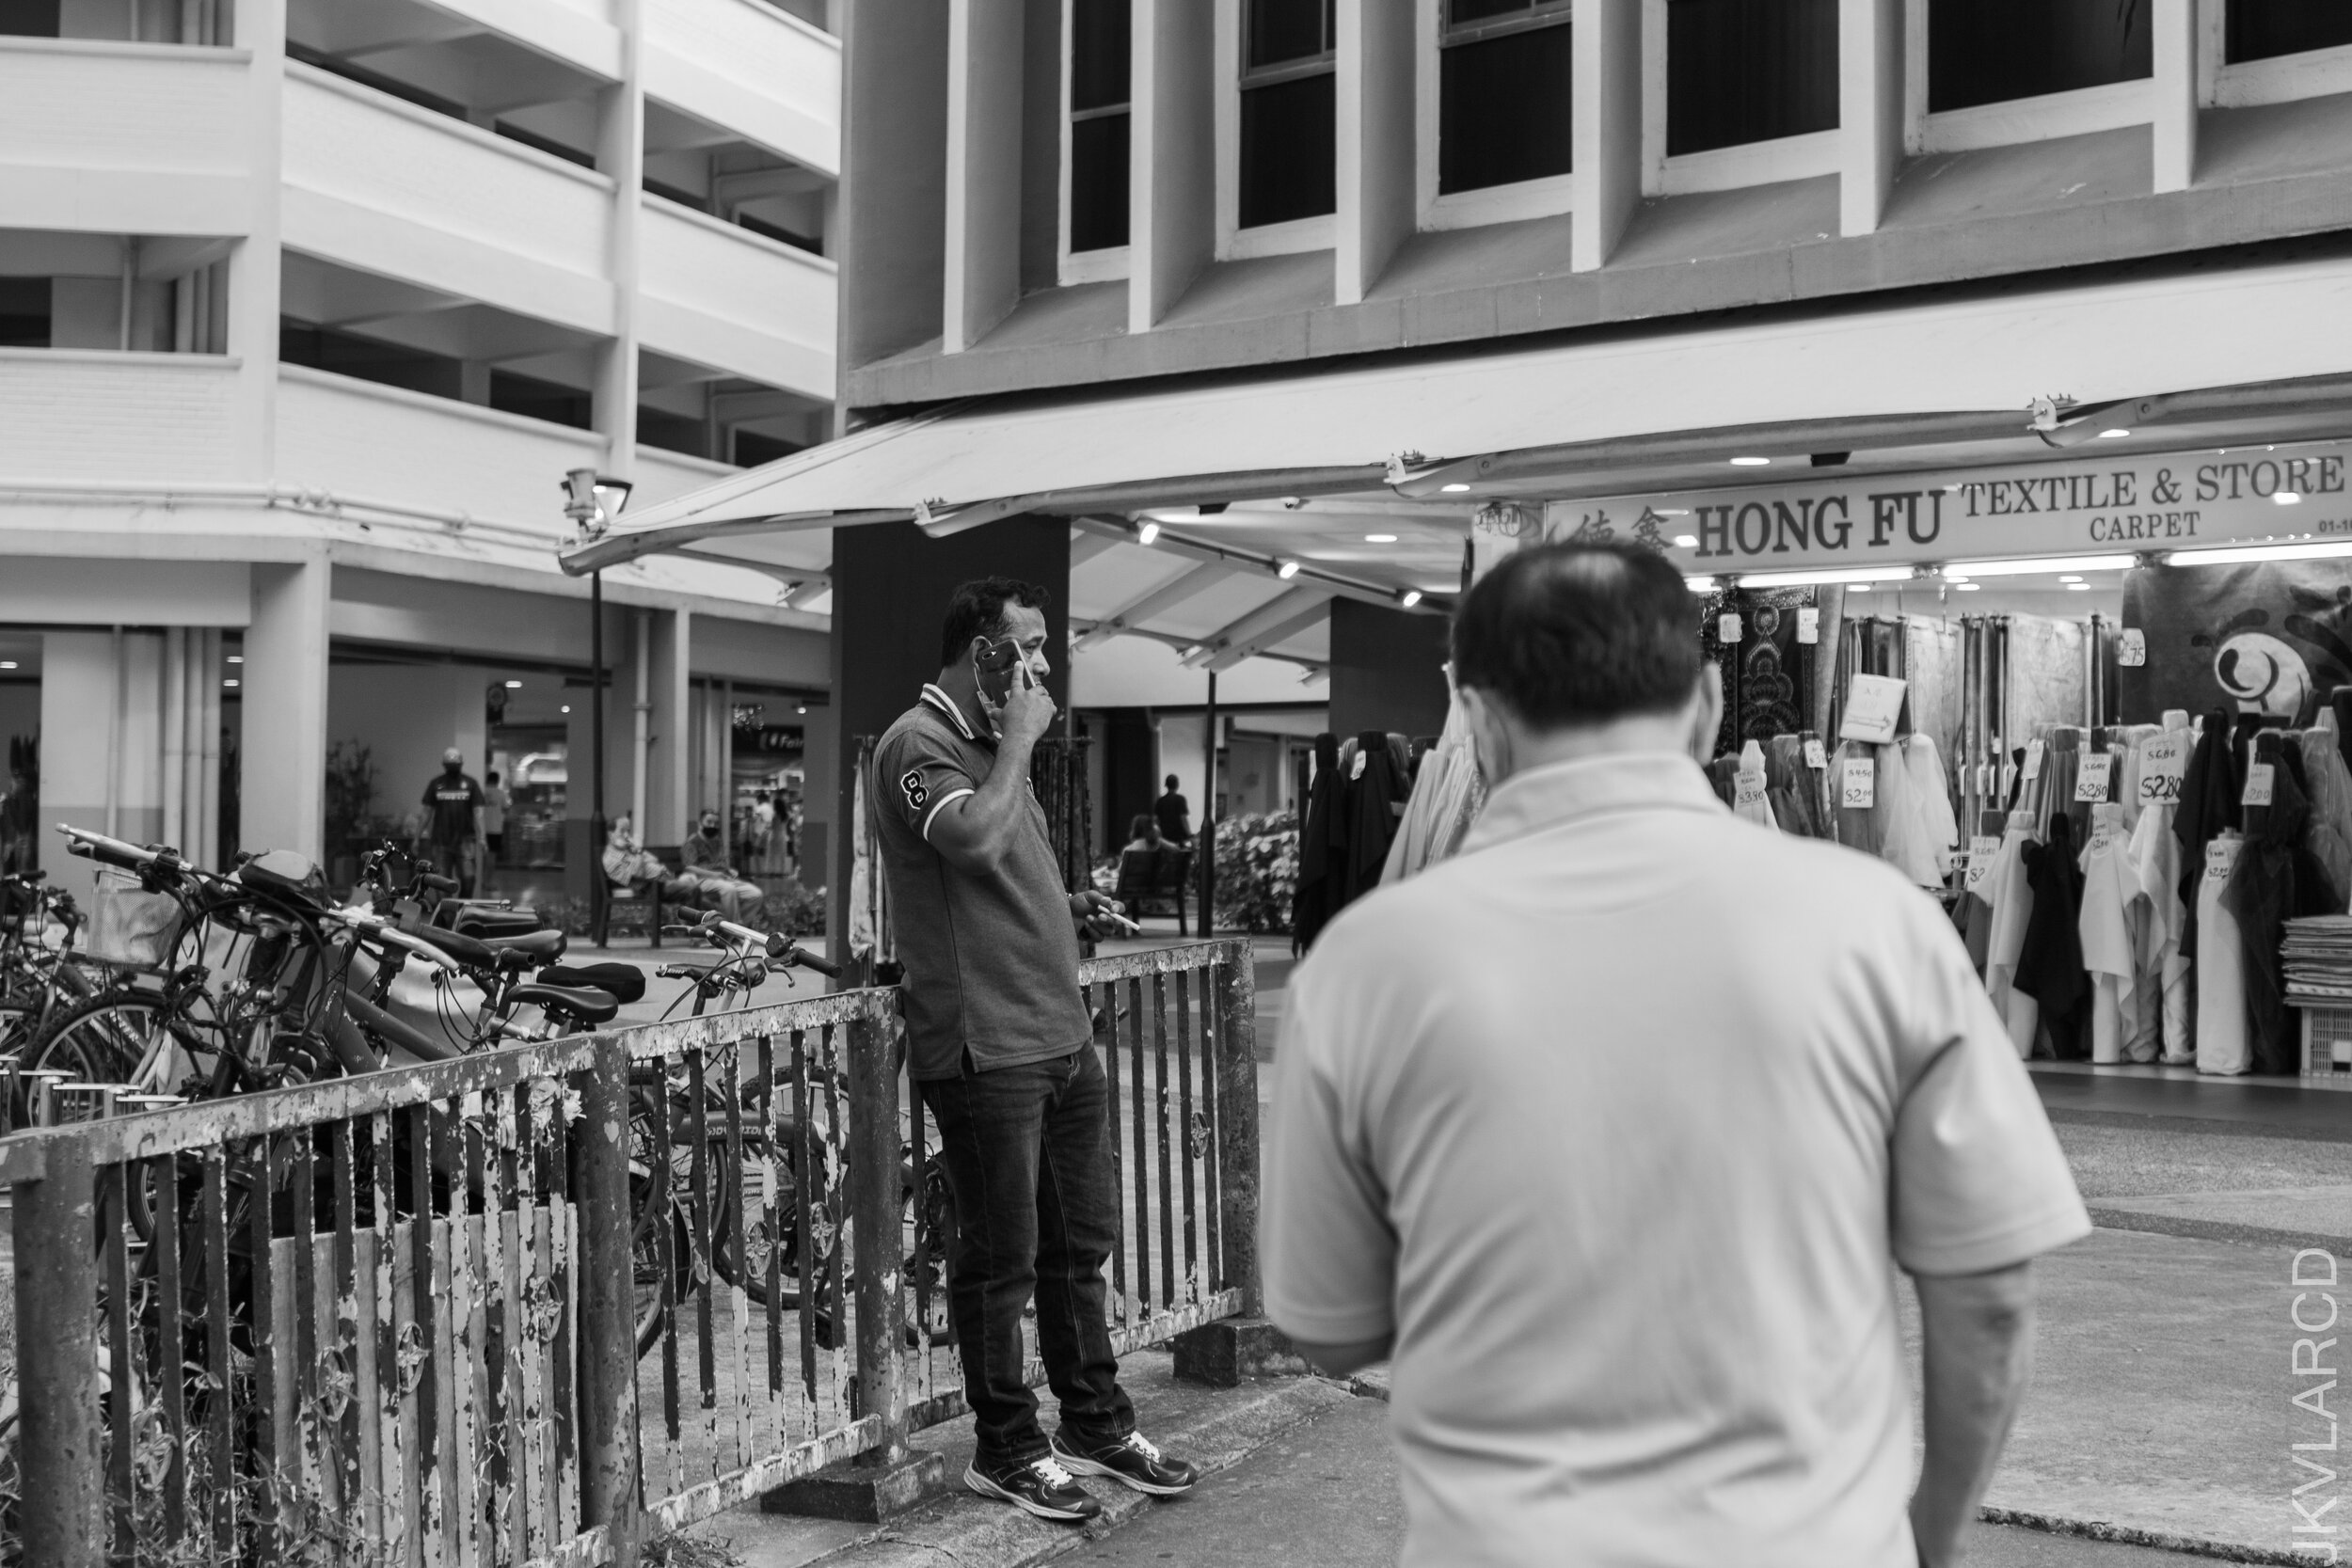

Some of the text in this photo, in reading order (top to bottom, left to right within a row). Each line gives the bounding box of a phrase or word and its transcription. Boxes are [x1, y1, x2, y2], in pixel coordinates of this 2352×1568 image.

[1694, 455, 2345, 558] HONG FU TEXTILE & STORE
[2090, 511, 2201, 542] CARPET
[900, 769, 930, 811] 8
